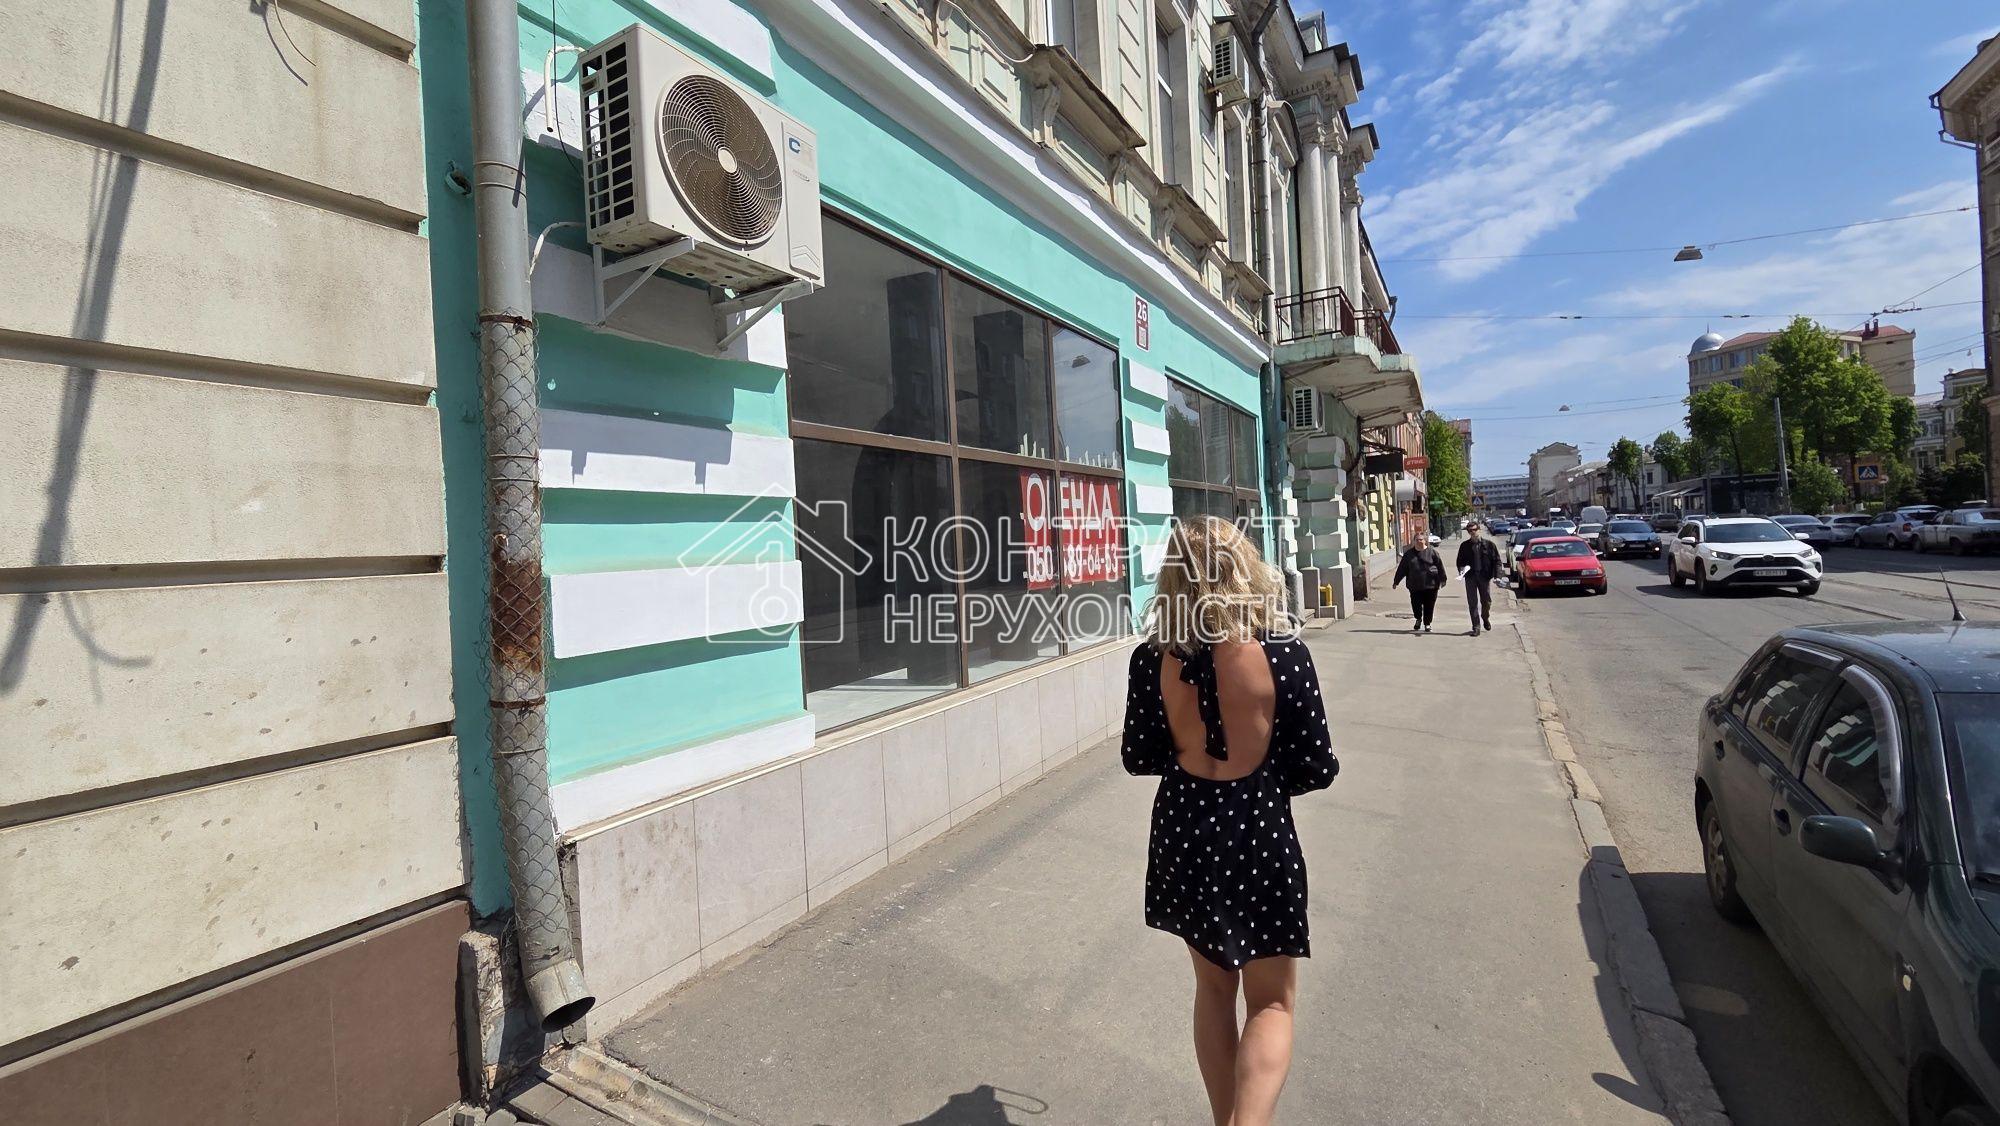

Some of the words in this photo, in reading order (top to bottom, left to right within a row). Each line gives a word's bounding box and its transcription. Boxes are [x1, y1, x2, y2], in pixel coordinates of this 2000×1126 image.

[1136, 300, 1148, 321] 26
[1027, 473, 1117, 539] ОЕНДА
[1028, 545, 1054, 582] 050
